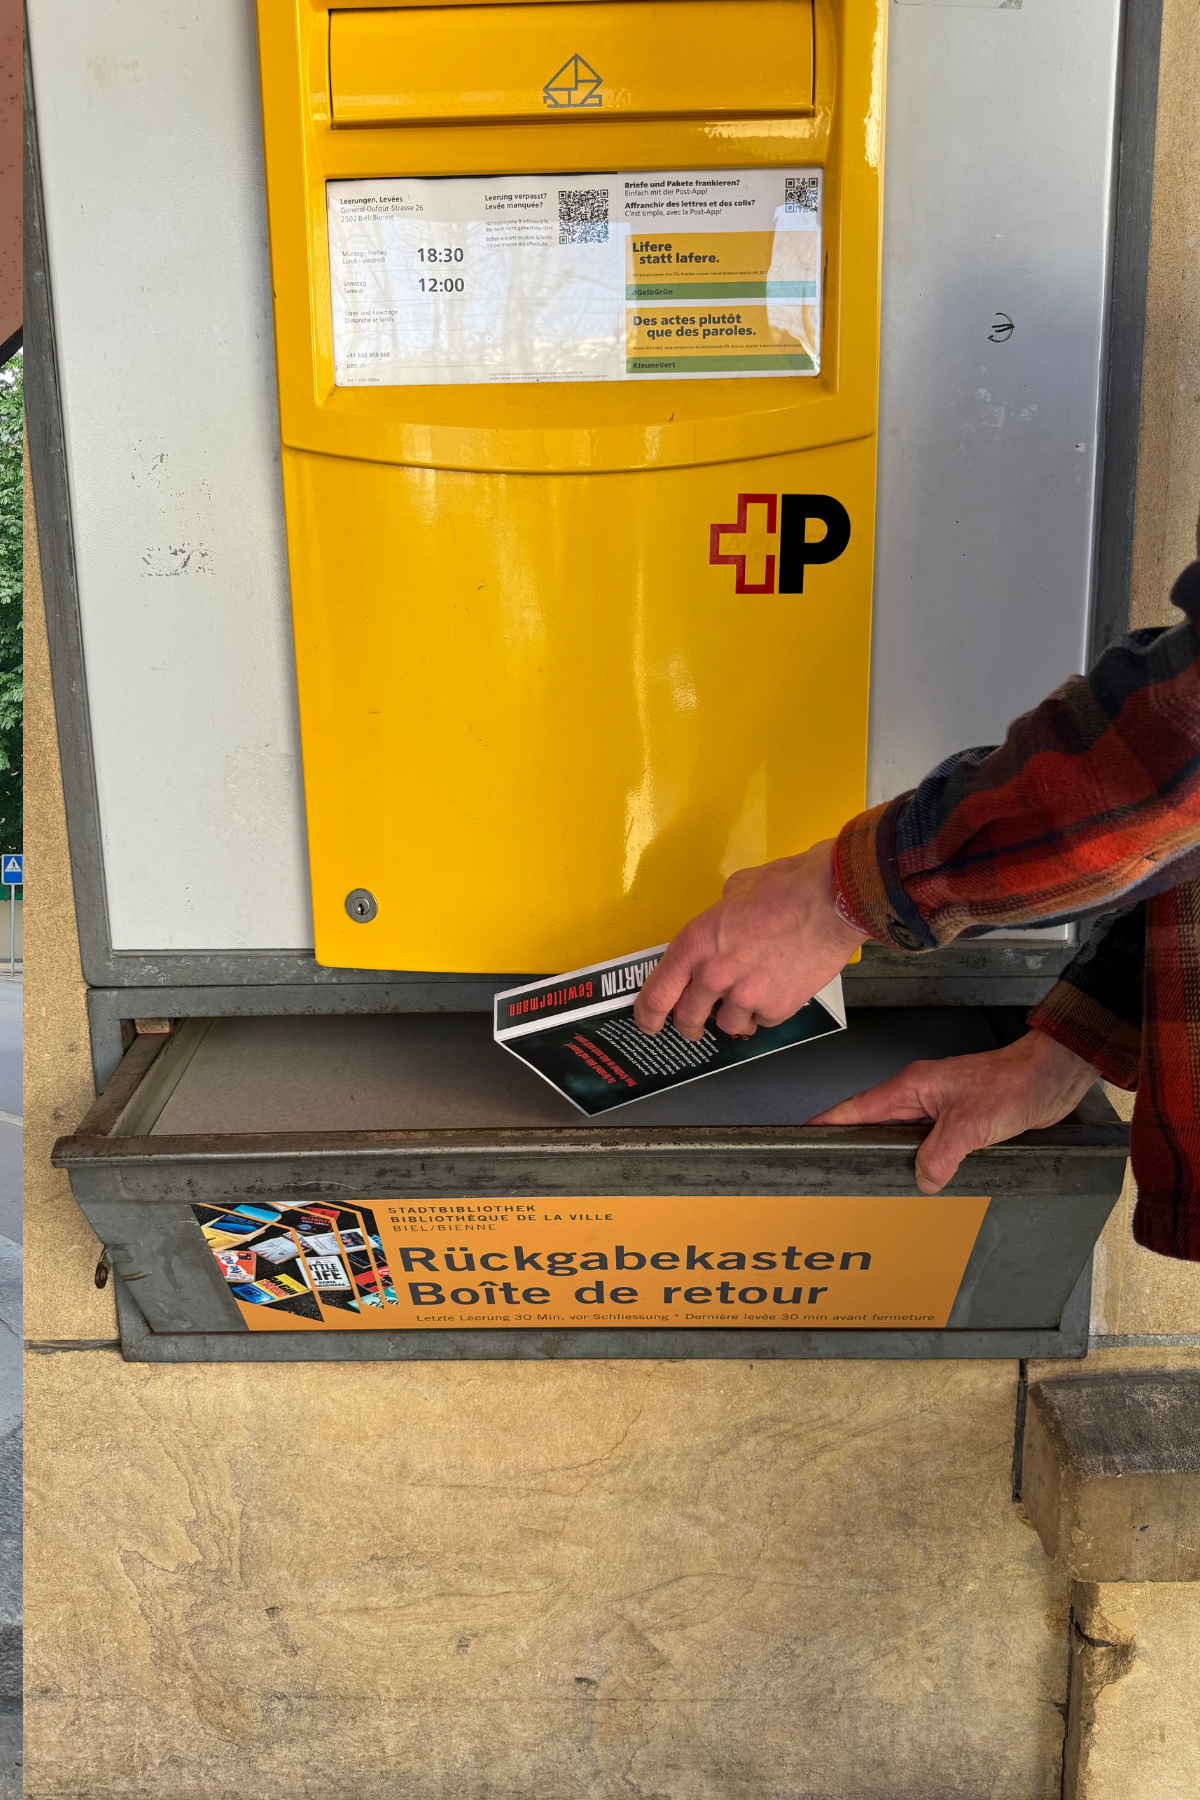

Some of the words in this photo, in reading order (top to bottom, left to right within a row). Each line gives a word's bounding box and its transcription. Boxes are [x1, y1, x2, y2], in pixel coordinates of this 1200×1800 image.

[650, 180, 665, 188] und
[695, 179, 740, 187] frankieren?
[485, 194, 512, 202] Leerung
[514, 192, 547, 201] verpasst?
[624, 189, 649, 197] Einfach
[650, 188, 662, 196] mit
[676, 188, 708, 196] Post-App!
[340, 197, 378, 205] Leerungen,
[379, 195, 403, 203] Levées
[506, 201, 543, 209] manquée?
[666, 200, 680, 208] des
[681, 200, 707, 208] lettres
[719, 199, 733, 207] des
[734, 199, 756, 207] colis?
[415, 204, 424, 212] 26
[642, 209, 665, 217] simple,
[666, 208, 681, 216] avec
[682, 208, 689, 216] la
[690, 207, 722, 216] Post-App!
[632, 242, 672, 252] Lifere
[416, 247, 465, 263] 18:30
[639, 253, 672, 265] statt
[675, 252, 720, 264] lafere.
[418, 277, 465, 293] 12:00
[633, 316, 657, 326] Des
[661, 315, 696, 326] actes
[699, 314, 742, 327] plutôt
[647, 329, 672, 340] que
[675, 326, 699, 337] des
[702, 326, 756, 339] paroles.
[633, 361, 676, 369] #JauneVert
[778, 493, 851, 594] P
[600, 957, 658, 998] MARTIN
[508, 980, 593, 1017] Gewittermann
[388, 1205, 536, 1214] STADTBIBLIOTHEK
[390, 1214, 510, 1223] BIBLIOTHÈQUE
[569, 1213, 614, 1221] VILLE
[392, 1224, 497, 1232] BIEL/BIENNE
[398, 1245, 872, 1277] Rückgabekasten
[408, 1281, 551, 1306] Boîte
[574, 1281, 638, 1305] de
[663, 1281, 828, 1304] retour
[460, 1314, 510, 1322] Leerung
[593, 1313, 669, 1321] Schliessung
[872, 1313, 935, 1321] fermeture
